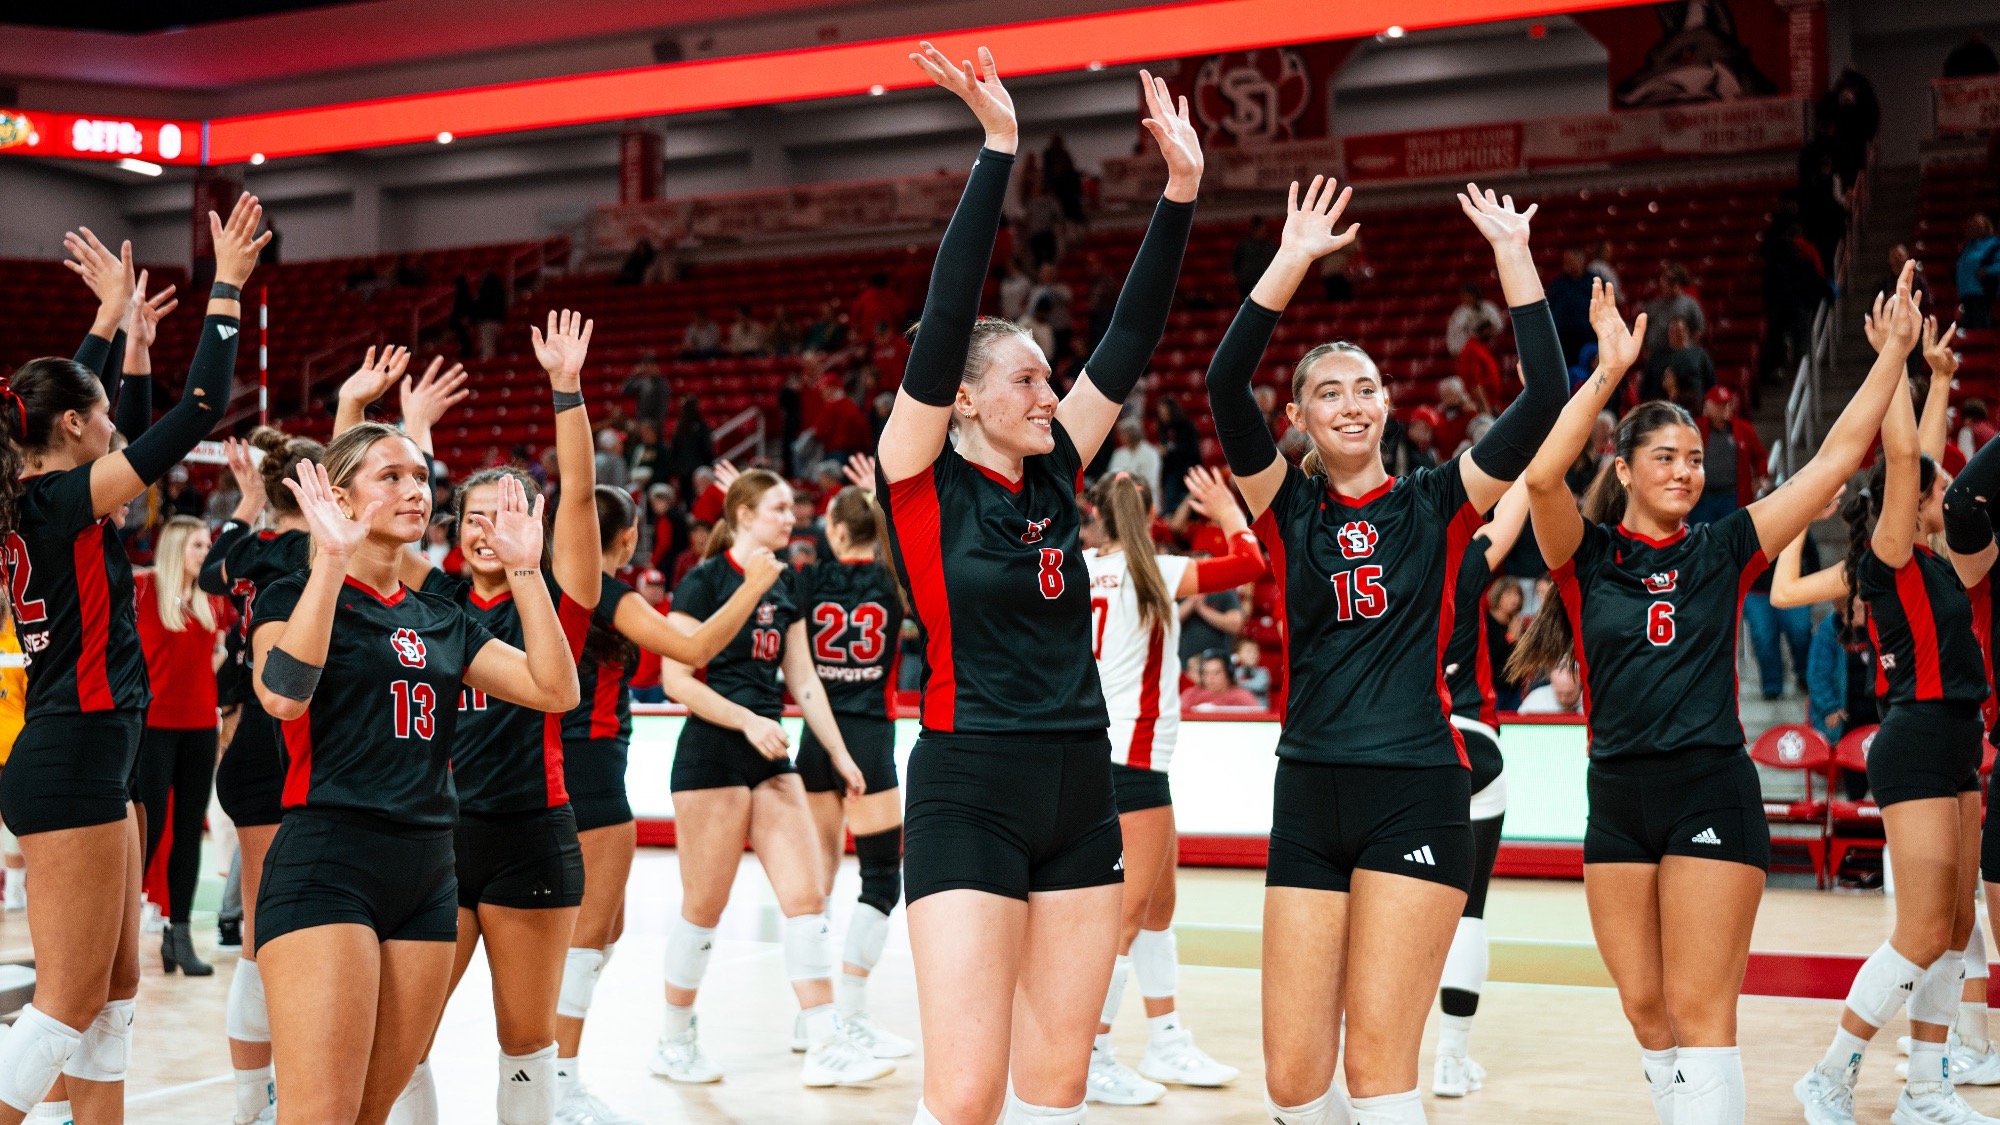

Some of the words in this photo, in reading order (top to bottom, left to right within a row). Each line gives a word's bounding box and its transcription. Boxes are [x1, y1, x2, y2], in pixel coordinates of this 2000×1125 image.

[158, 123, 182, 159] 0
[1405, 146, 1515, 177] CHAMPIONS
[1038, 548, 1065, 599] 8
[1330, 565, 1388, 622] 15
[752, 628, 781, 660] 10
[813, 601, 888, 663] 23
[1647, 600, 1675, 646] 6
[816, 664, 883, 683] COYOTES
[390, 680, 436, 741] 13
